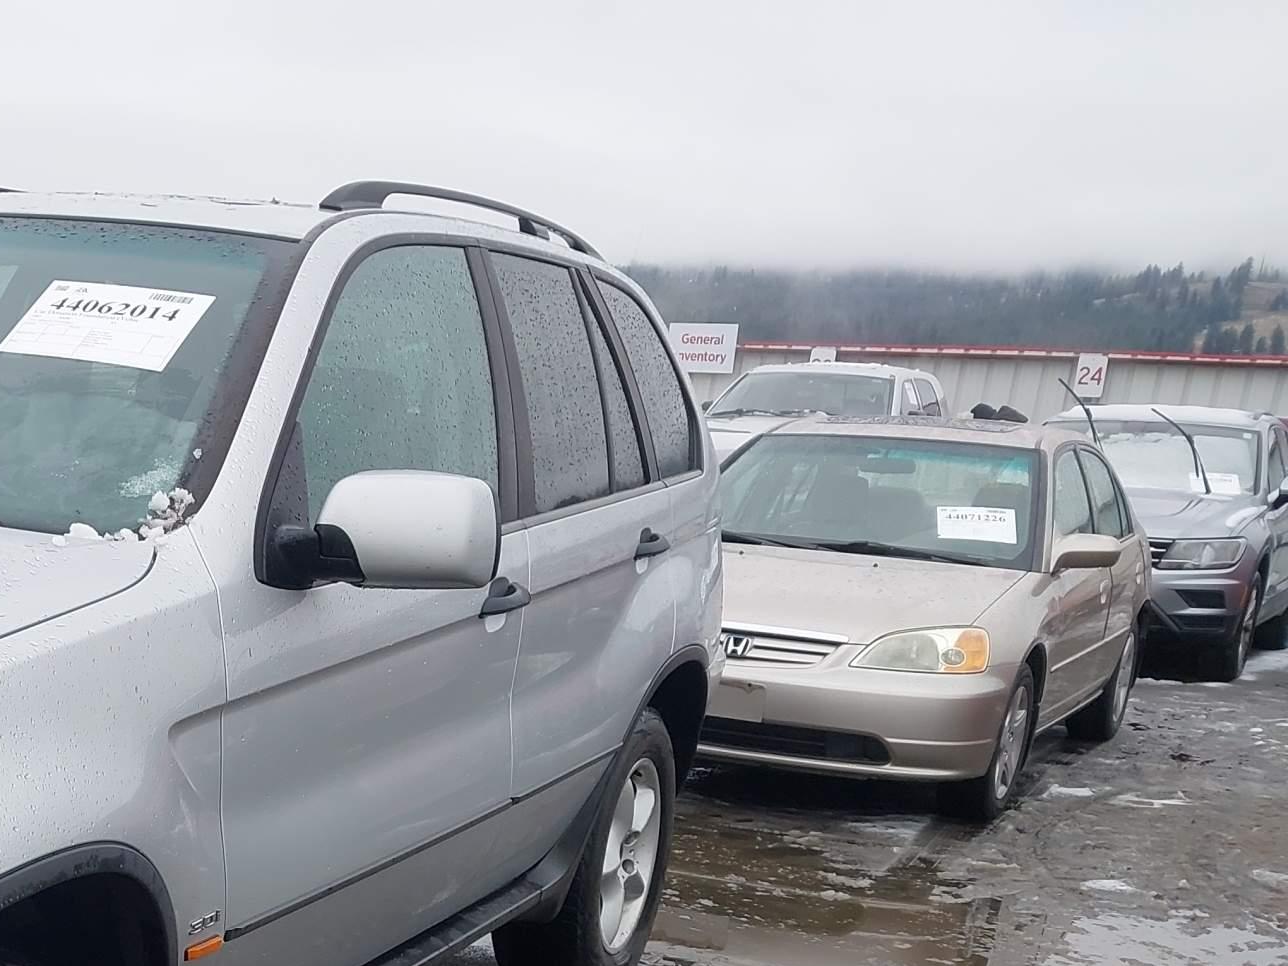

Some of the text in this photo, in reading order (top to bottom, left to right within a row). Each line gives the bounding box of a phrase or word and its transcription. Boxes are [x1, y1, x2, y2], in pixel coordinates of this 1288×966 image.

[50, 297, 181, 322] 44062014
[681, 333, 725, 346] General
[679, 351, 727, 364] nventory
[1078, 366, 1103, 386] 24
[945, 513, 1007, 522] 44071226
